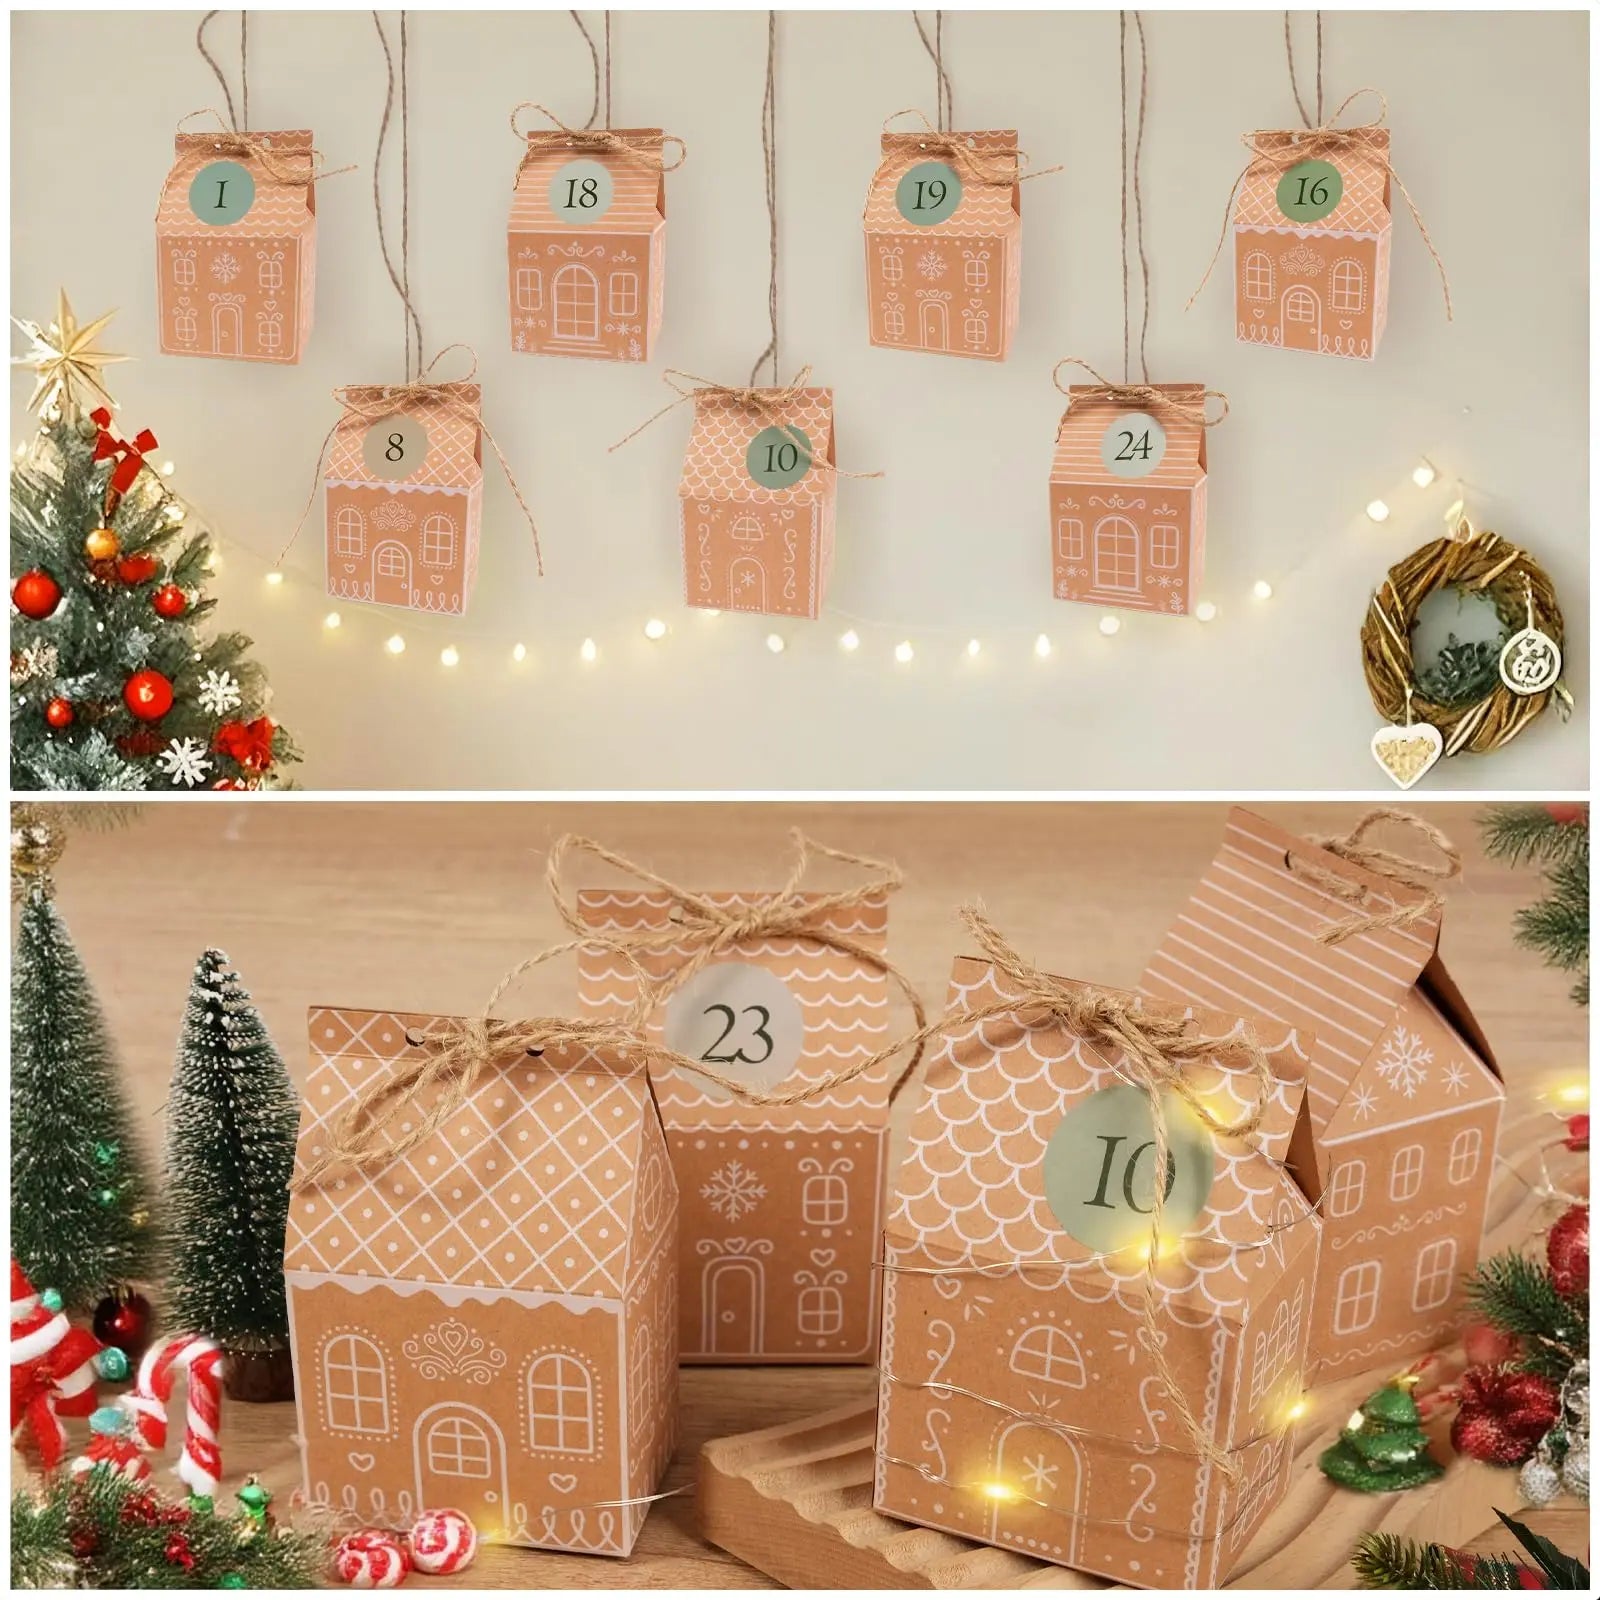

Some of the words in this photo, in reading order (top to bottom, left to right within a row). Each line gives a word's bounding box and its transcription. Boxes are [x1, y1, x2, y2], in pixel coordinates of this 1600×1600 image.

[214, 180, 229, 209] 1
[563, 178, 598, 209] 18
[911, 180, 947, 210] 19
[1293, 176, 1329, 206] 16
[384, 432, 404, 462] 8
[763, 442, 798, 473] 10
[1114, 429, 1154, 462] 24
[700, 1004, 774, 1065] 23
[1083, 1135, 1176, 1214] 10
